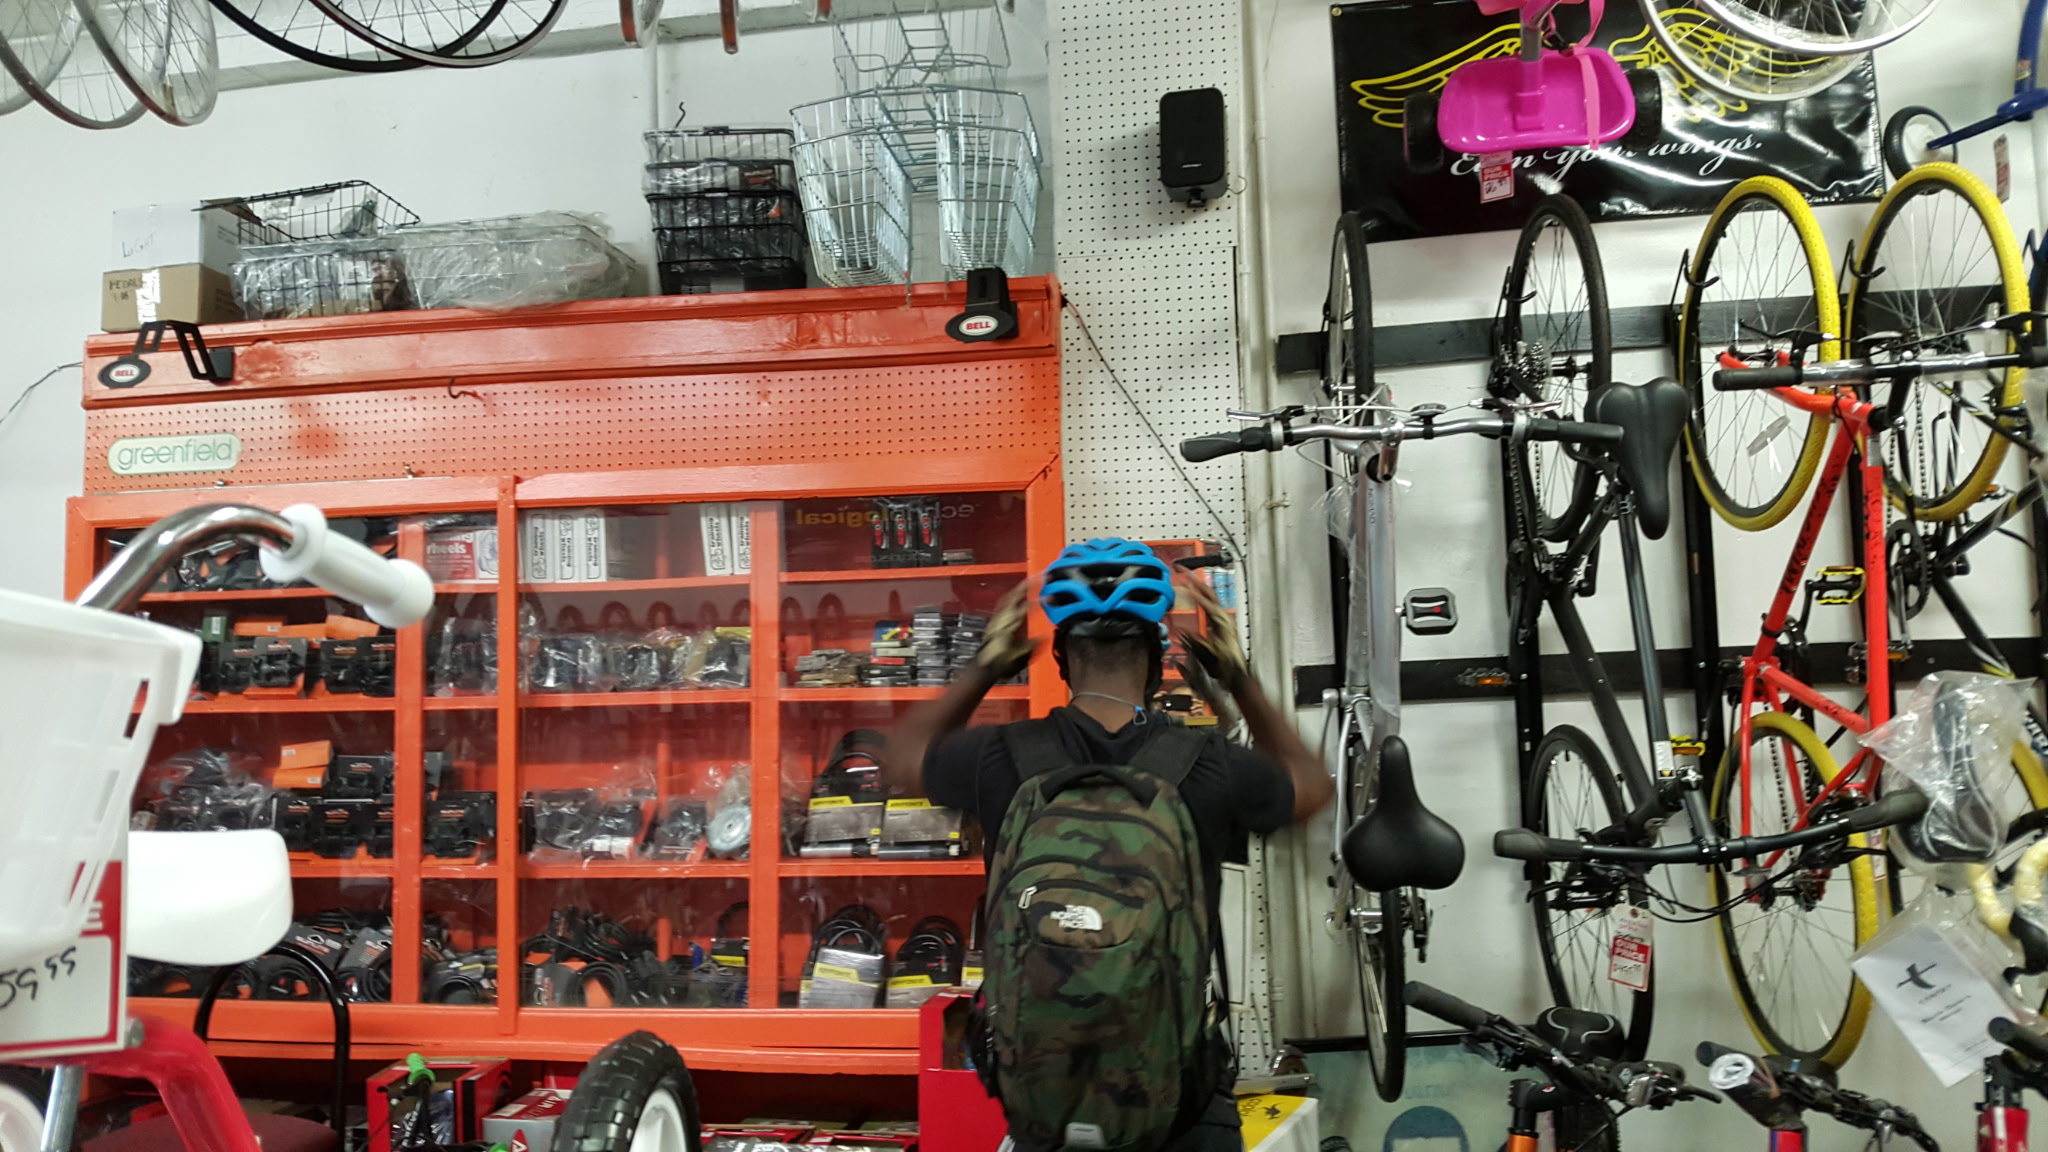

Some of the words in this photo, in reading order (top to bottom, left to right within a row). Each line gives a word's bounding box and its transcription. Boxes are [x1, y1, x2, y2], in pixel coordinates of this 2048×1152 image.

[1450, 152, 1538, 175] En
[1648, 133, 1762, 176] wings.
[965, 321, 992, 330] BELL
[115, 369, 135, 377] BELL
[117, 438, 232, 470] greenfield
